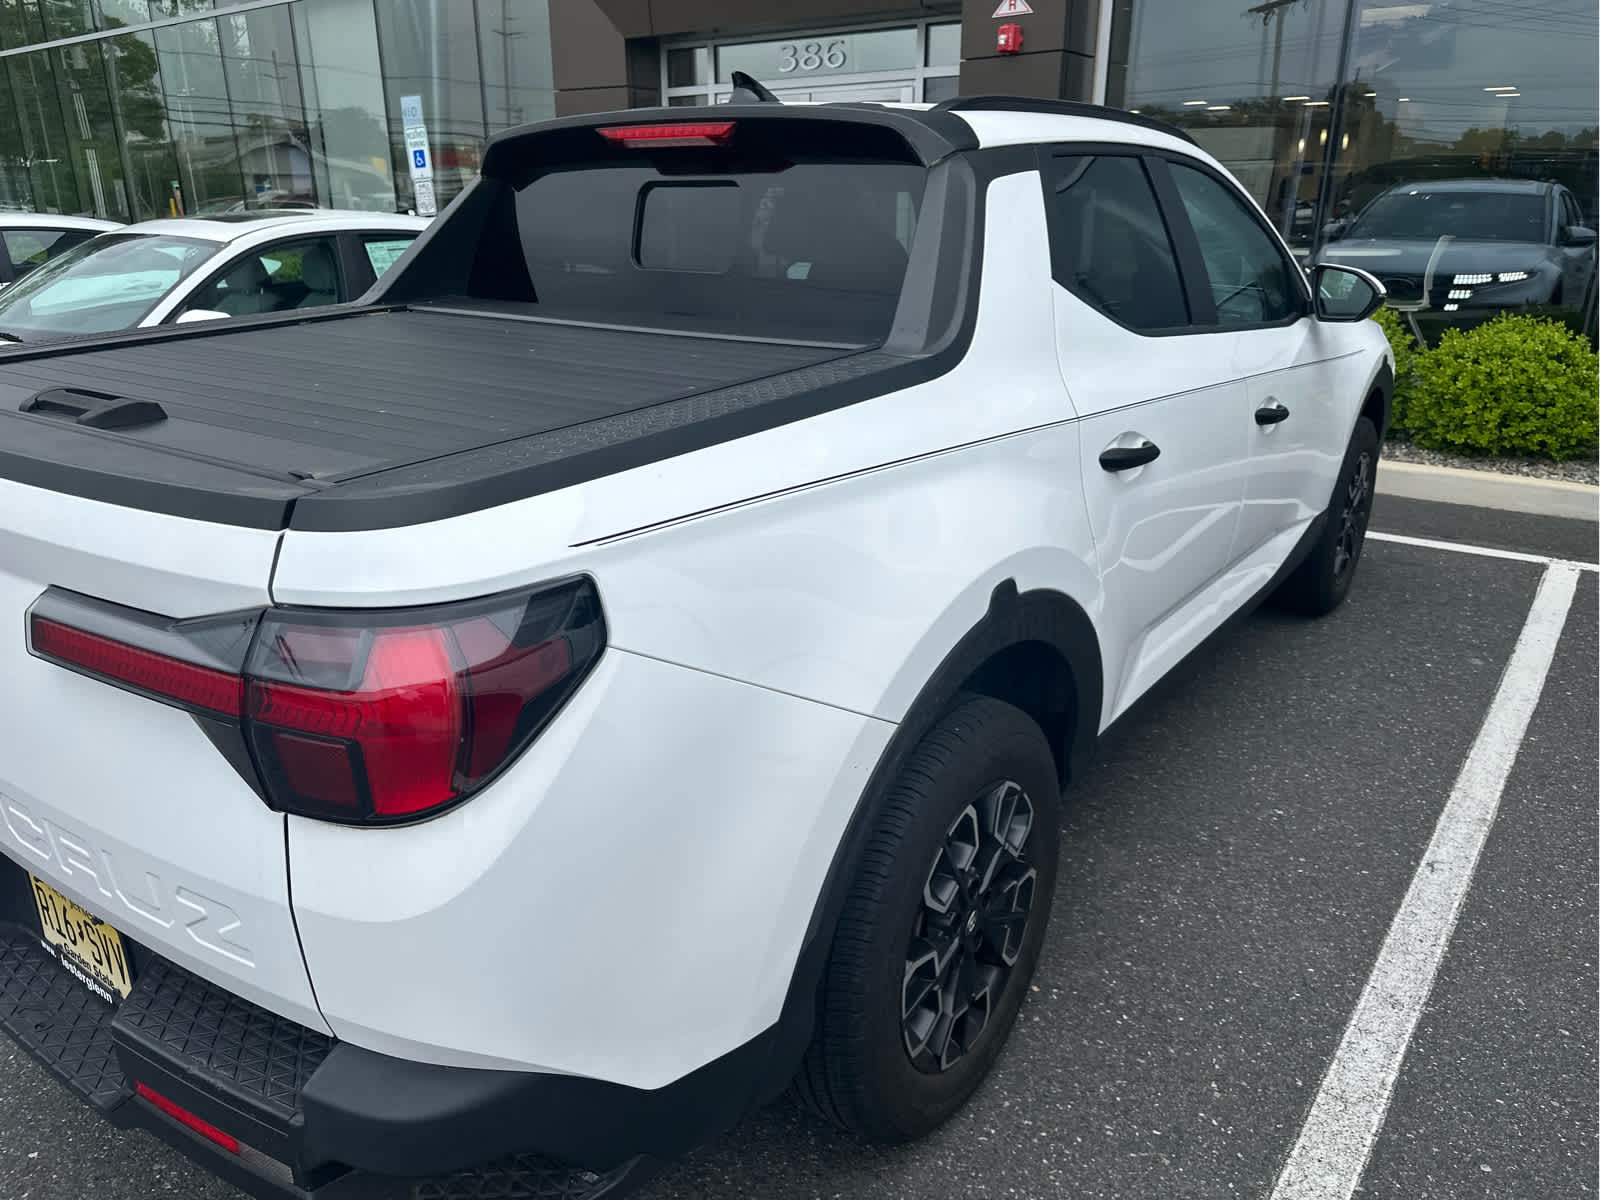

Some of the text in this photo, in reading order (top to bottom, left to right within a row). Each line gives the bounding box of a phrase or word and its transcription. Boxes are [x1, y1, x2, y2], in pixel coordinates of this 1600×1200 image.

[779, 40, 847, 73] 386
[0, 791, 256, 968] CRUZ
[60, 953, 113, 1004] lesterglenn
[63, 942, 115, 988] Garden State
